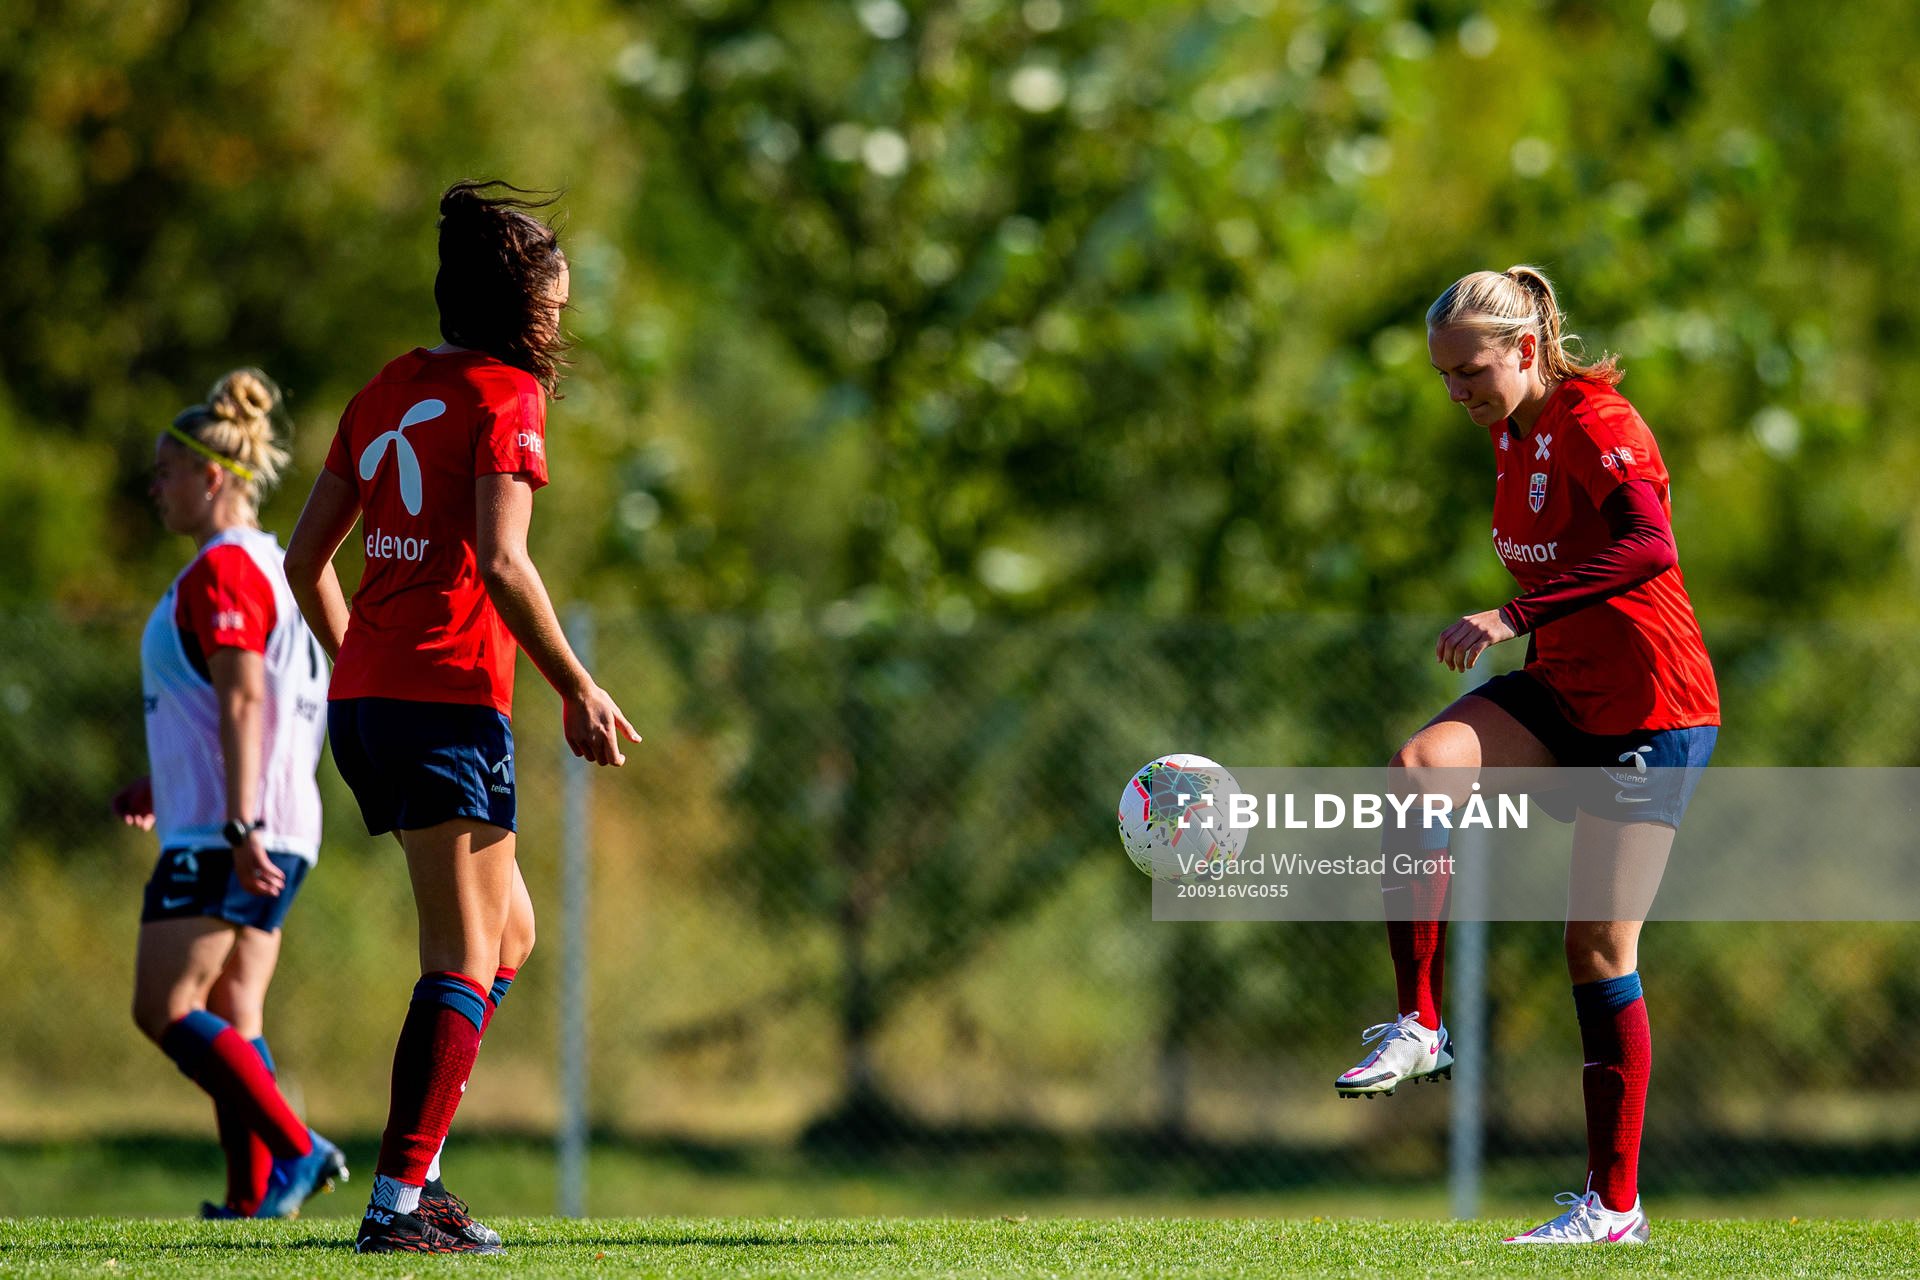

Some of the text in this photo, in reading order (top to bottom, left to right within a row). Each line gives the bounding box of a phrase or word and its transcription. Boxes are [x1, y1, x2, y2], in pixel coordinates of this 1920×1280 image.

[1600, 447, 1633, 468] DNB
[366, 527, 430, 562] elenor
[1498, 537, 1558, 562] telenor
[1616, 772, 1648, 784] telenor
